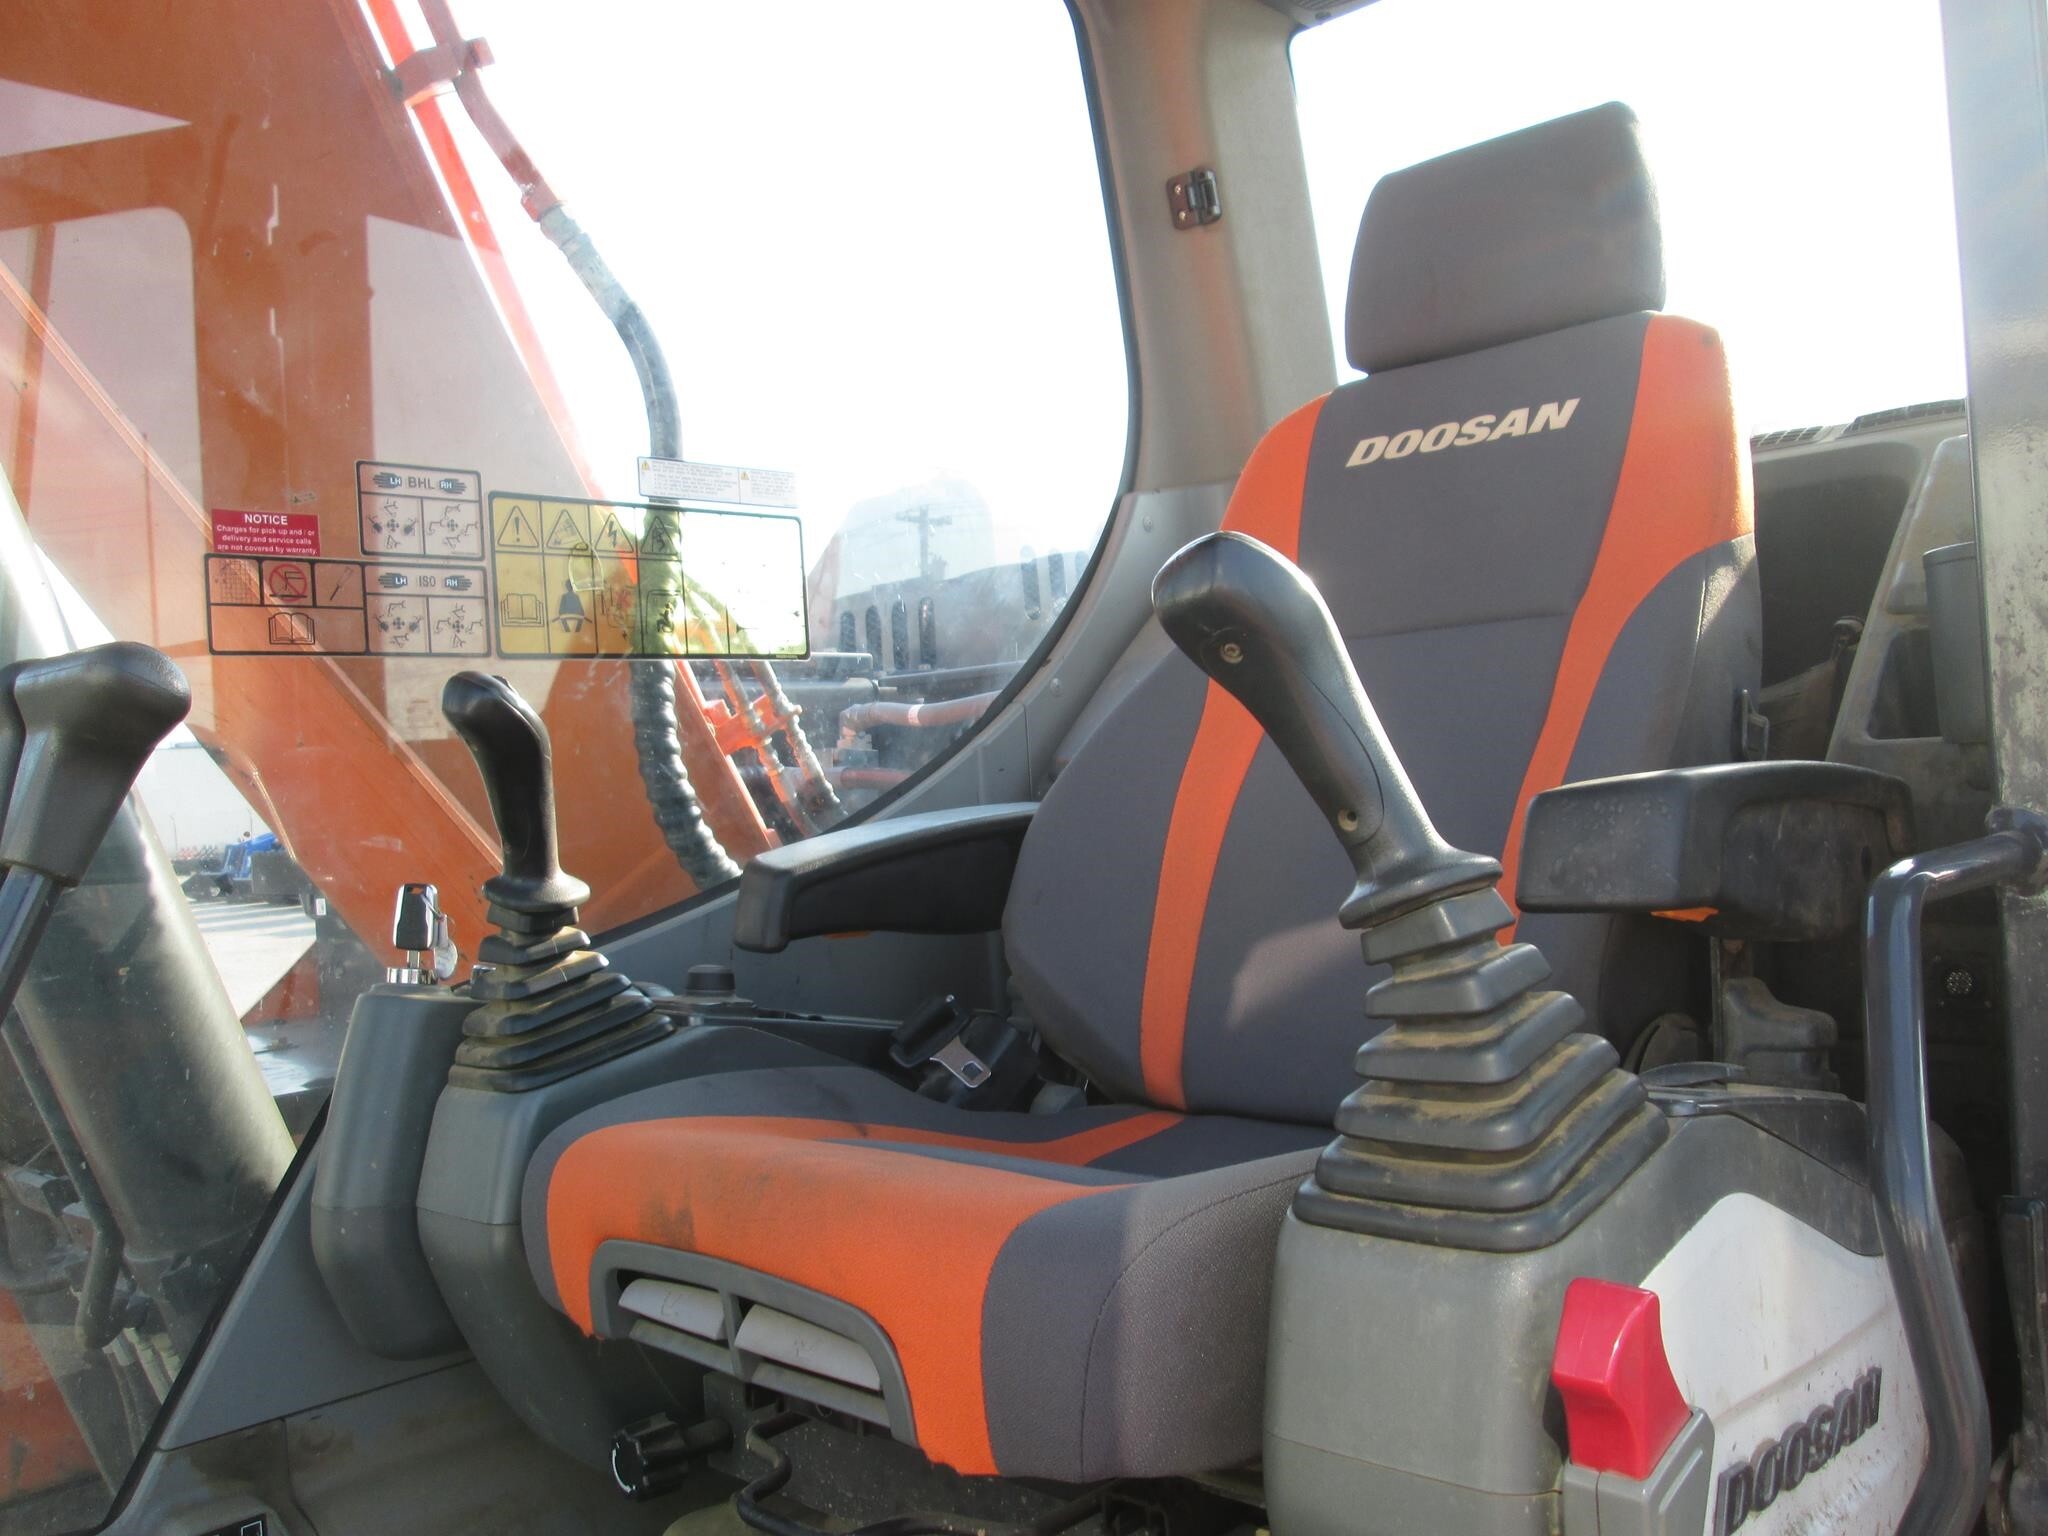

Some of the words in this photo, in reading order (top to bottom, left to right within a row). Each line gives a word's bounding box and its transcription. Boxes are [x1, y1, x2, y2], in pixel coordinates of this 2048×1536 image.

[1345, 397, 1581, 468] DOOSAN
[390, 477, 401, 485] LH
[408, 476, 435, 490] BHL
[244, 513, 288, 525] NOTICE
[216, 524, 247, 534] Charges
[261, 527, 276, 535] pick
[222, 534, 251, 543] delivery
[268, 537, 294, 545] service
[244, 545, 274, 553] covered
[275, 546, 285, 554] by
[286, 547, 318, 556] warranty.
[395, 576, 407, 585] LH
[418, 576, 436, 587] ISO
[1713, 1366, 1883, 1536] DOOSAN
